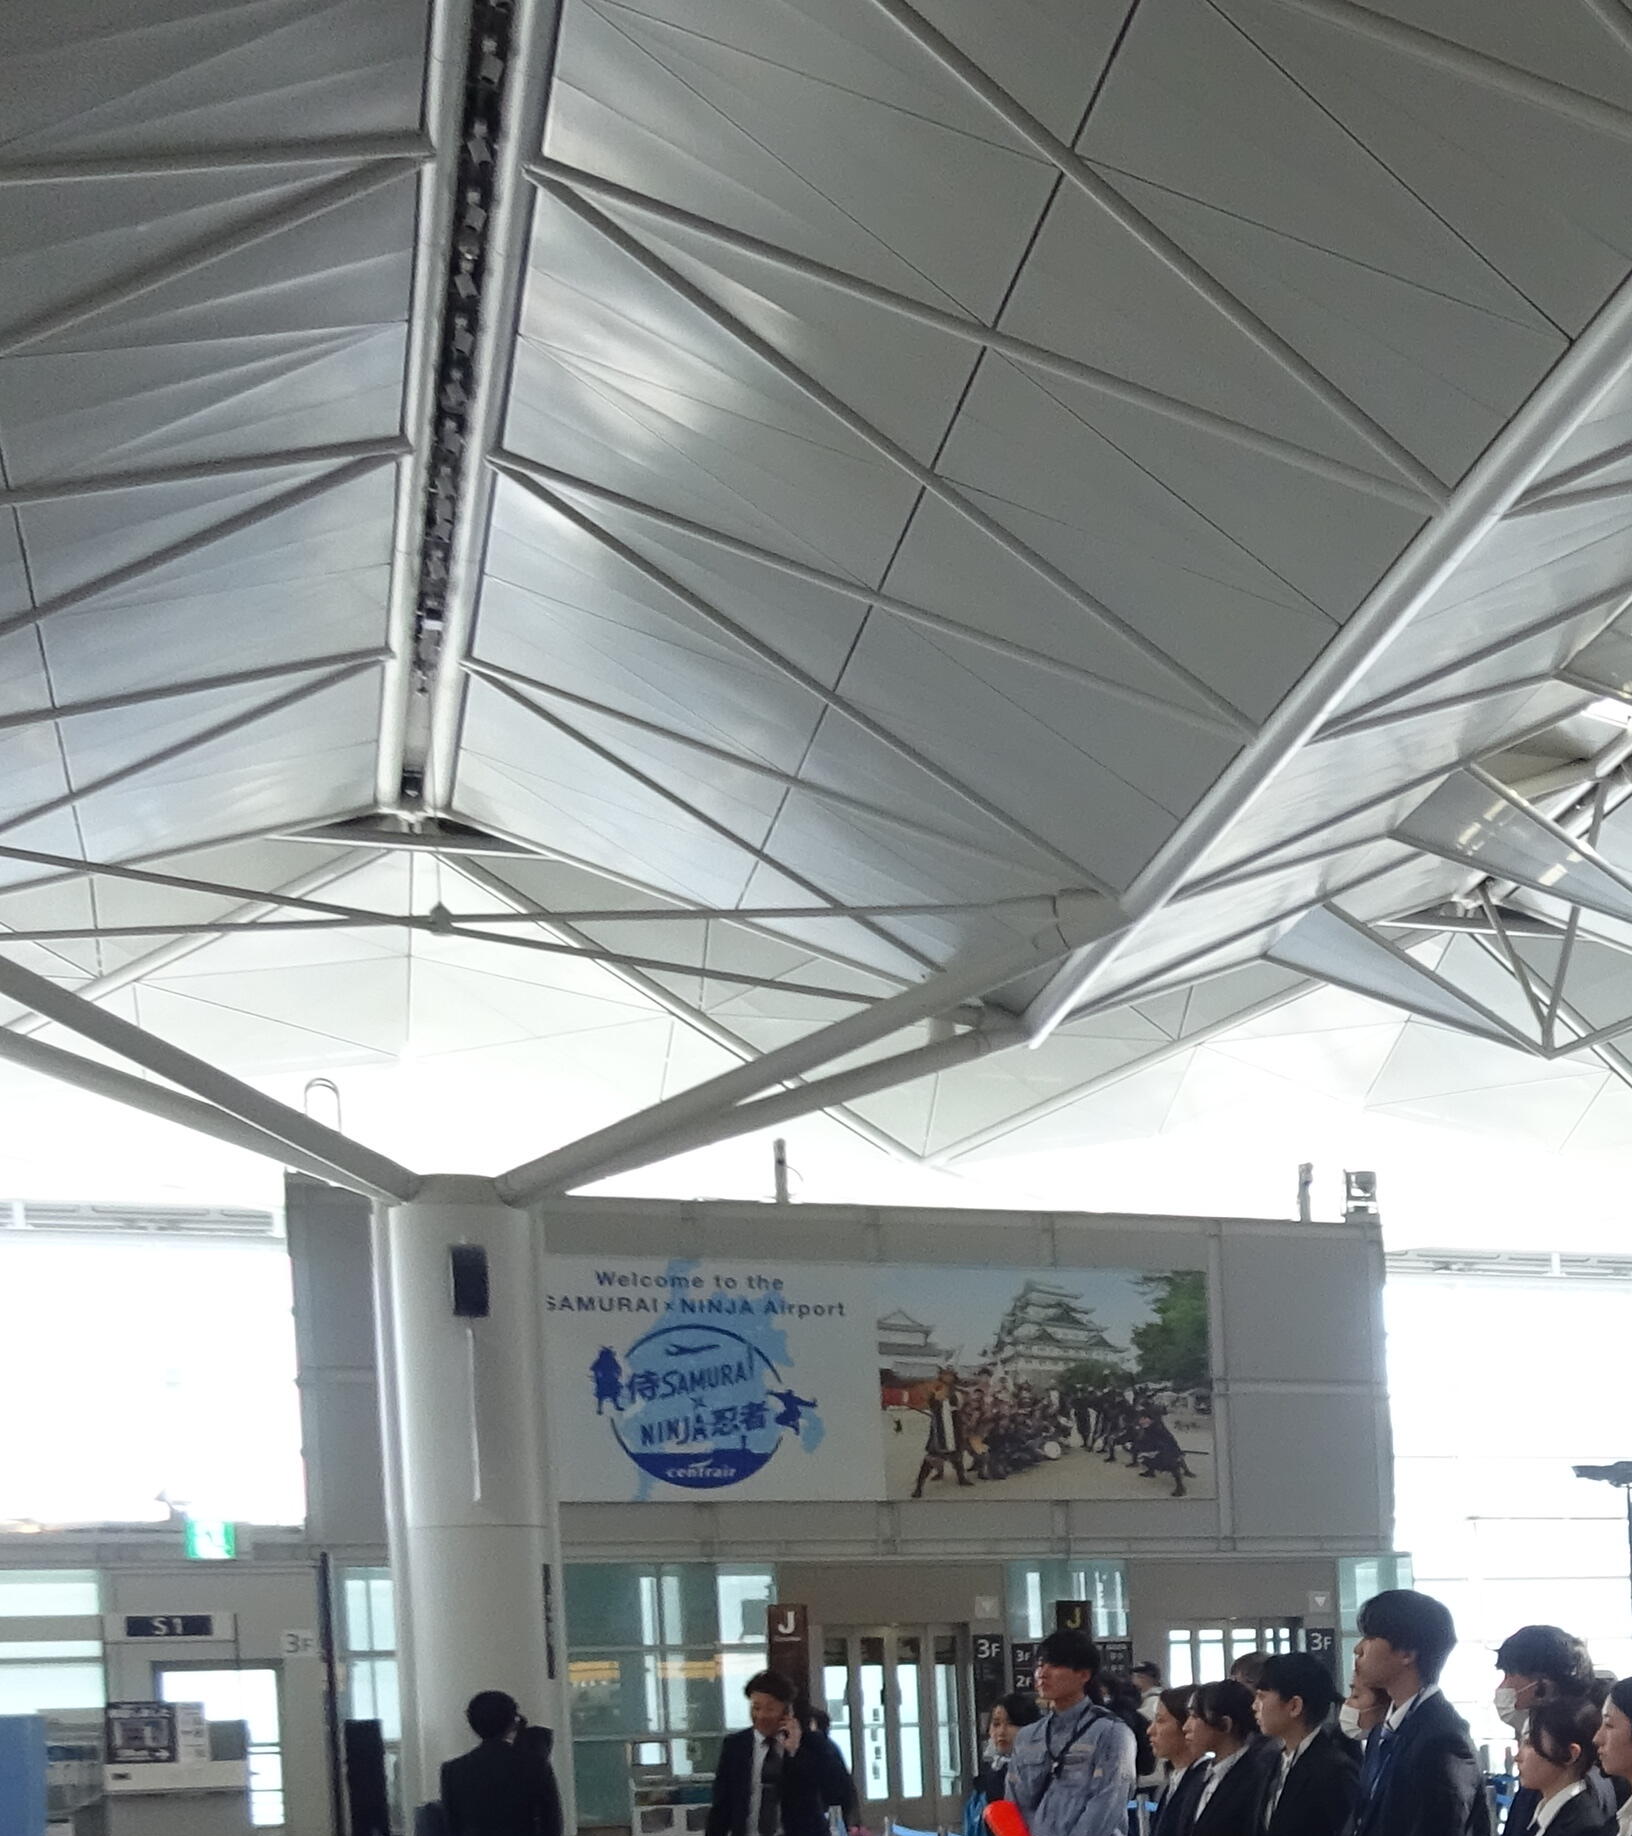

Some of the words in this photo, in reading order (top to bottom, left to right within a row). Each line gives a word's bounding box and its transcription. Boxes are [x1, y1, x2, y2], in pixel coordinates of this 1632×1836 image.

[595, 1270, 704, 1290] Welcome
[715, 1275, 738, 1290] to
[748, 1271, 785, 1291] the
[764, 1298, 848, 1320] Airport
[151, 1616, 184, 1636] S1
[777, 1610, 796, 1634] J
[1067, 1607, 1082, 1629] J
[286, 1633, 315, 1654] 3F
[977, 1638, 1001, 1658] 3F
[1310, 1632, 1332, 1650] 3F
[1015, 1649, 1031, 1662] 3F
[1015, 1675, 1032, 1687] 2F
